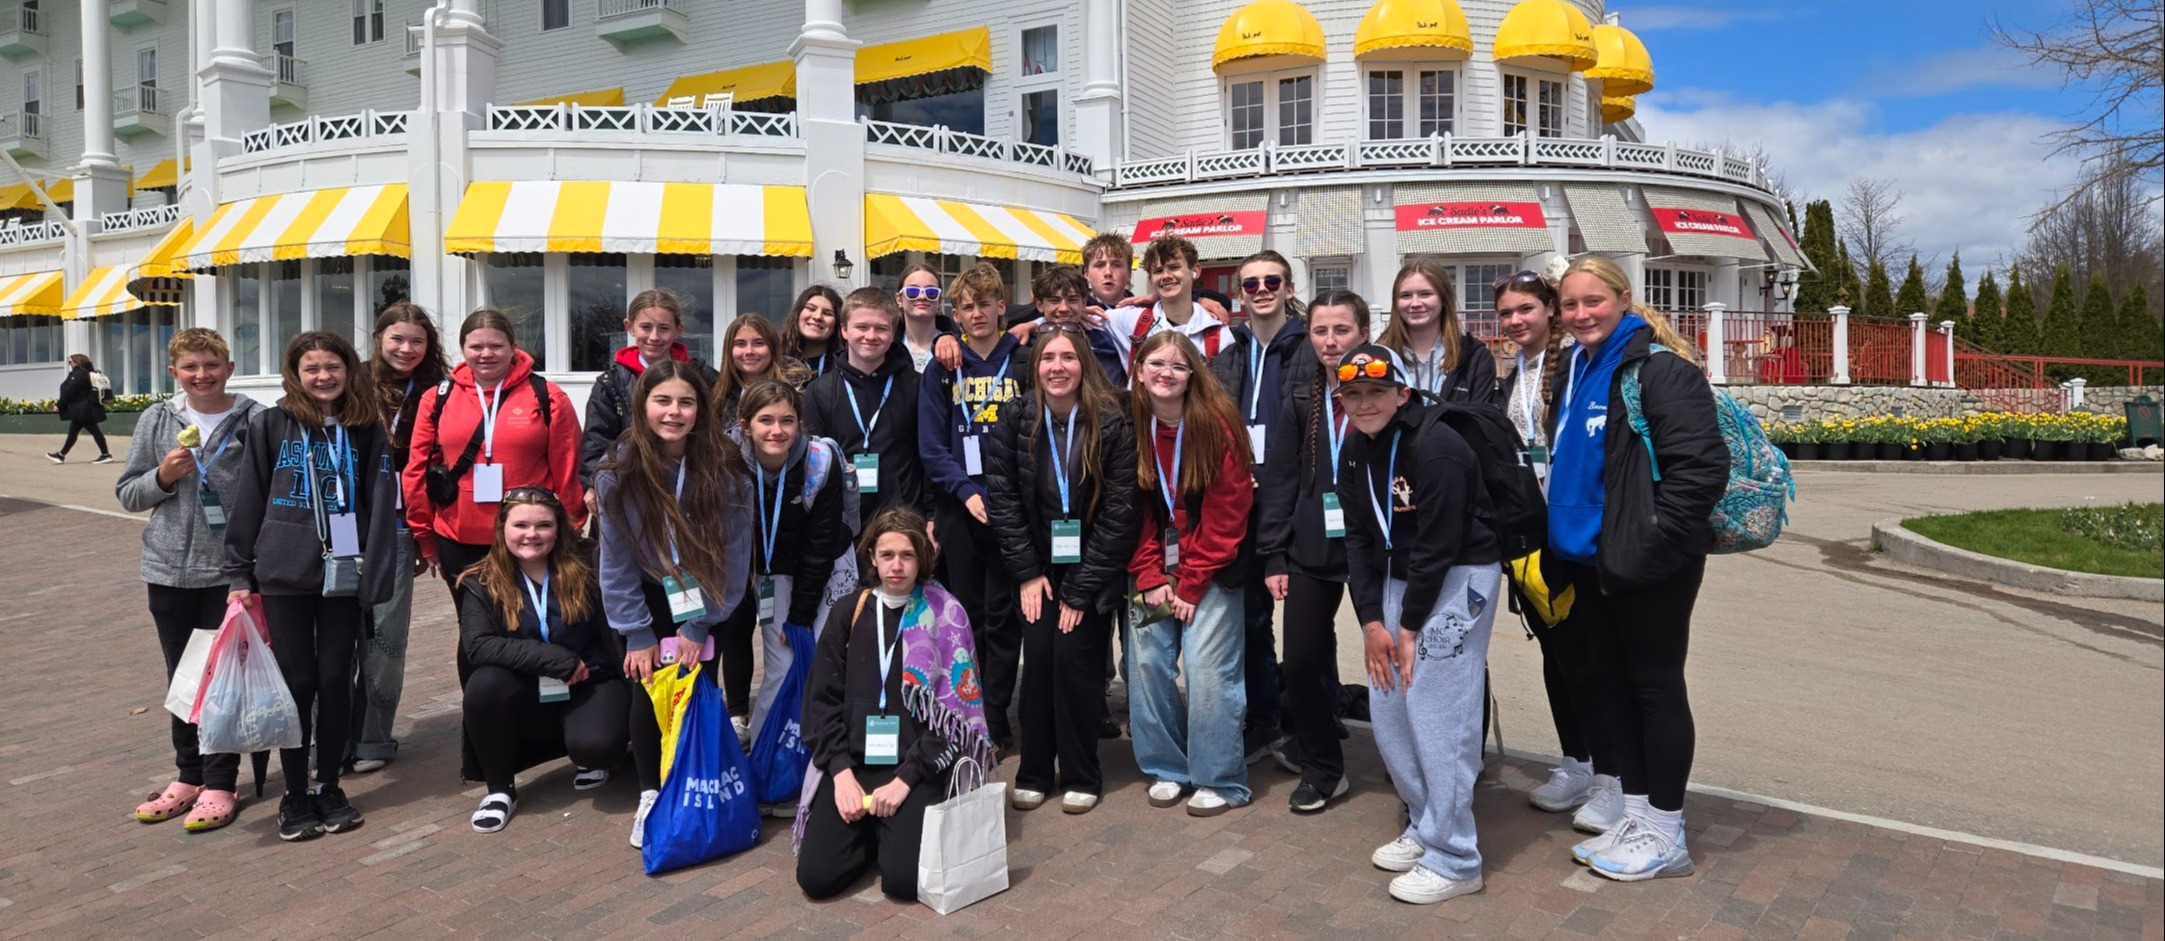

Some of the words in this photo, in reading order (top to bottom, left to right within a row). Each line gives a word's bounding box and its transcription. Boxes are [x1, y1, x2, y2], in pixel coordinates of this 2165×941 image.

[1450, 206, 1487, 216] Sadie's
[1181, 216, 1214, 228] Sadie's
[1418, 218, 1437, 226] ICE
[1438, 217, 1478, 225] CREAM
[1480, 216, 1524, 224] PARLOR
[1203, 224, 1243, 233] PARLOR
[1674, 221, 1689, 229] ICE
[1689, 222, 1715, 231] CREAM
[1714, 224, 1742, 234] PARLOR
[973, 404, 998, 422] M
[1431, 627, 1446, 636] MC
[1425, 635, 1451, 644] CHOIR
